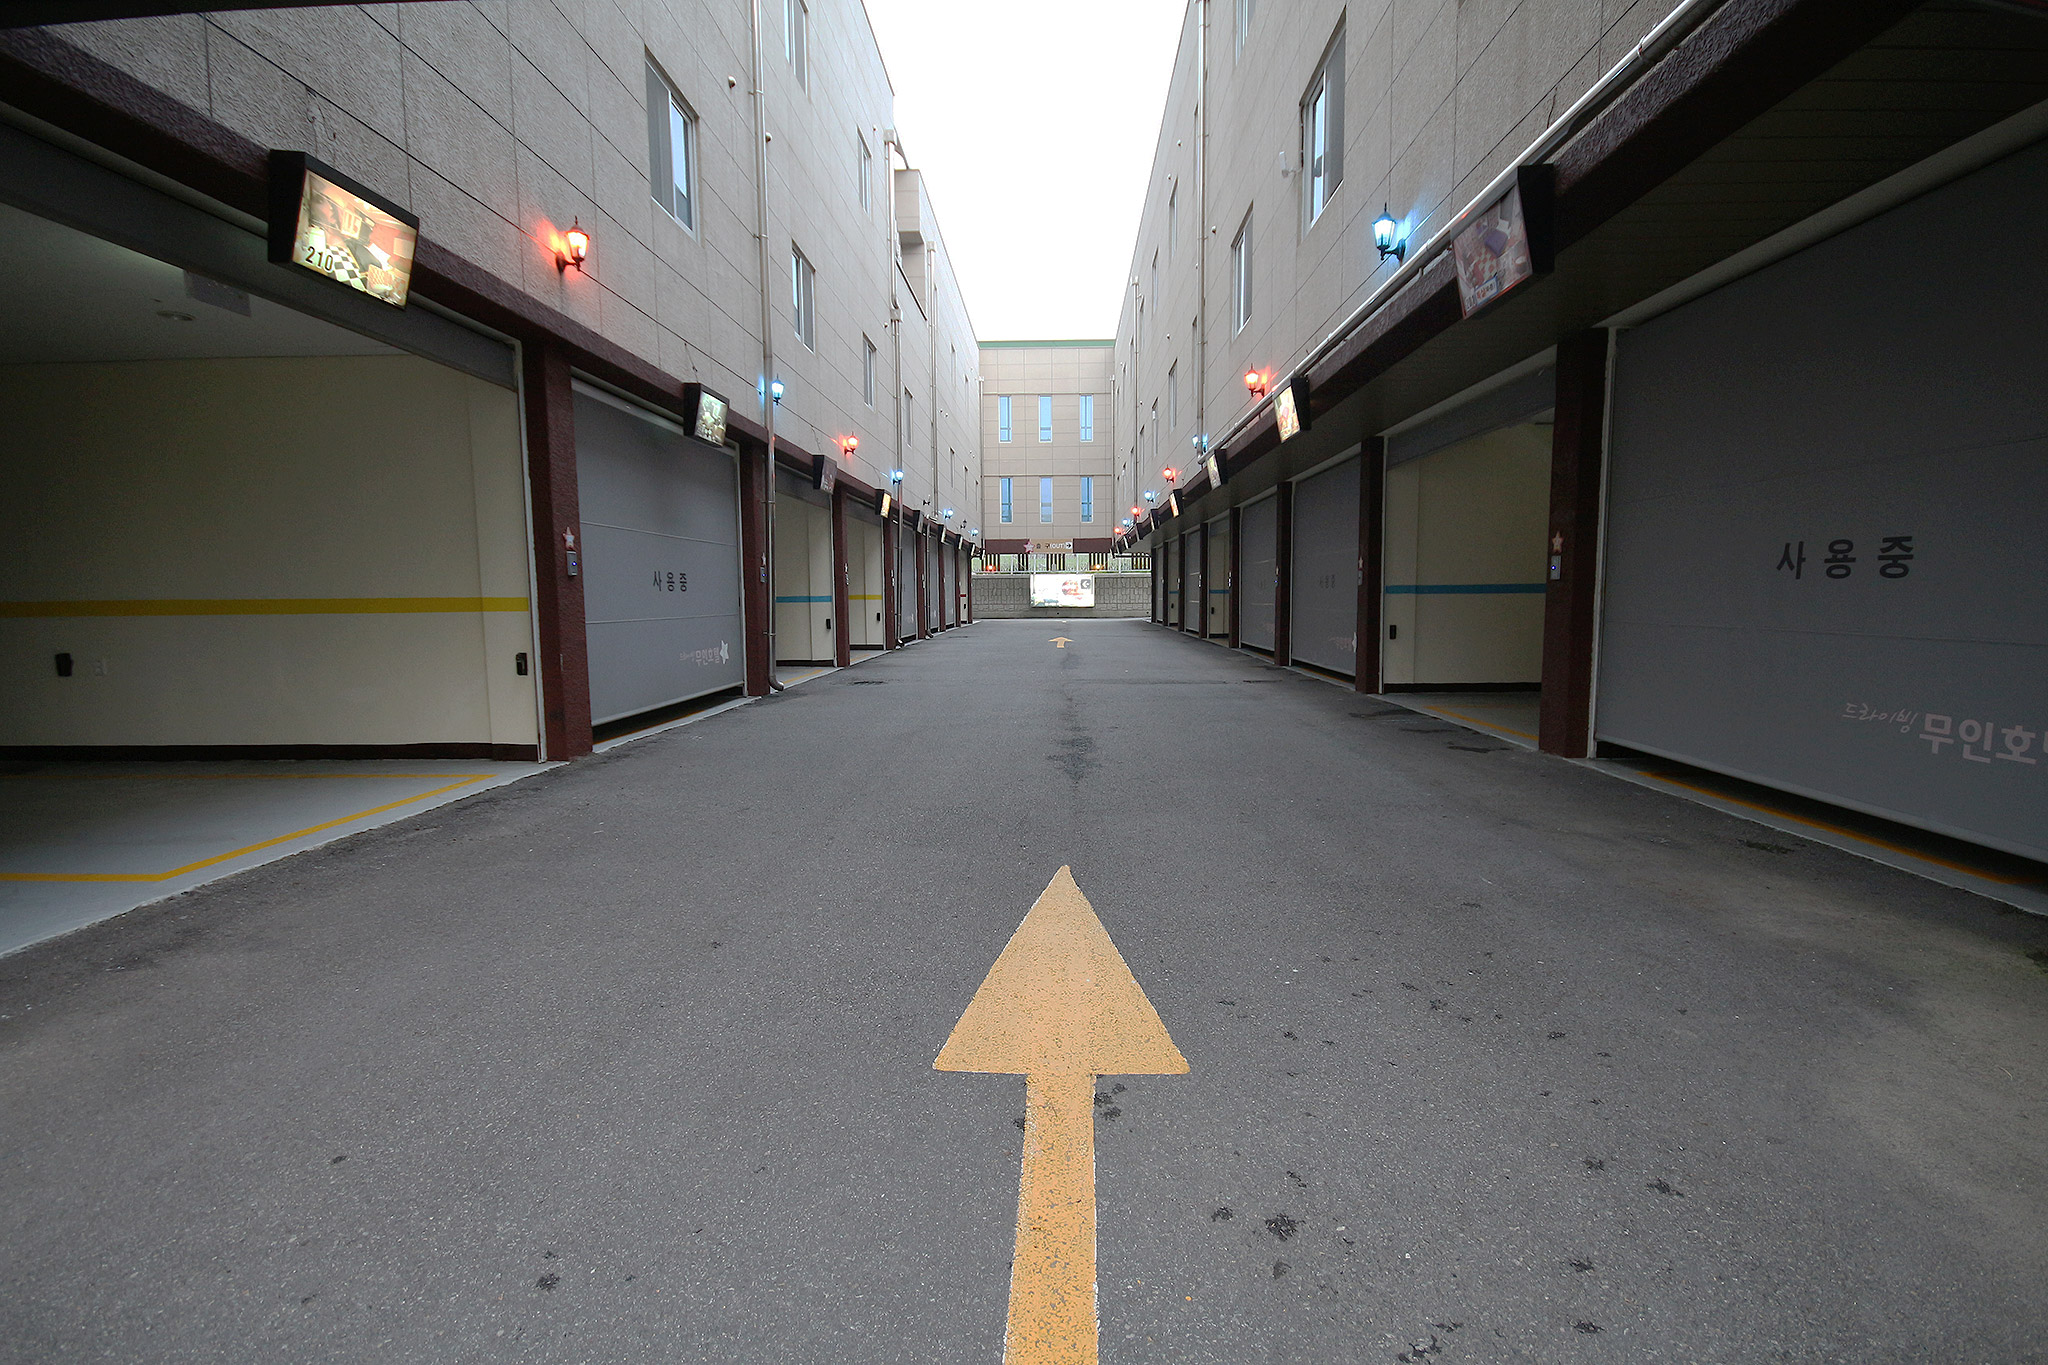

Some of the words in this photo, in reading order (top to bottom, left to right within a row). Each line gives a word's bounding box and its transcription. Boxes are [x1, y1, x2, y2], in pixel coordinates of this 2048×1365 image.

[305, 245, 334, 272] 210
[1776, 535, 1914, 580] 사용중
[653, 571, 687, 592] 사용중
[1842, 702, 1918, 734] 드라이빙
[1919, 713, 2048, 765] 무인호
